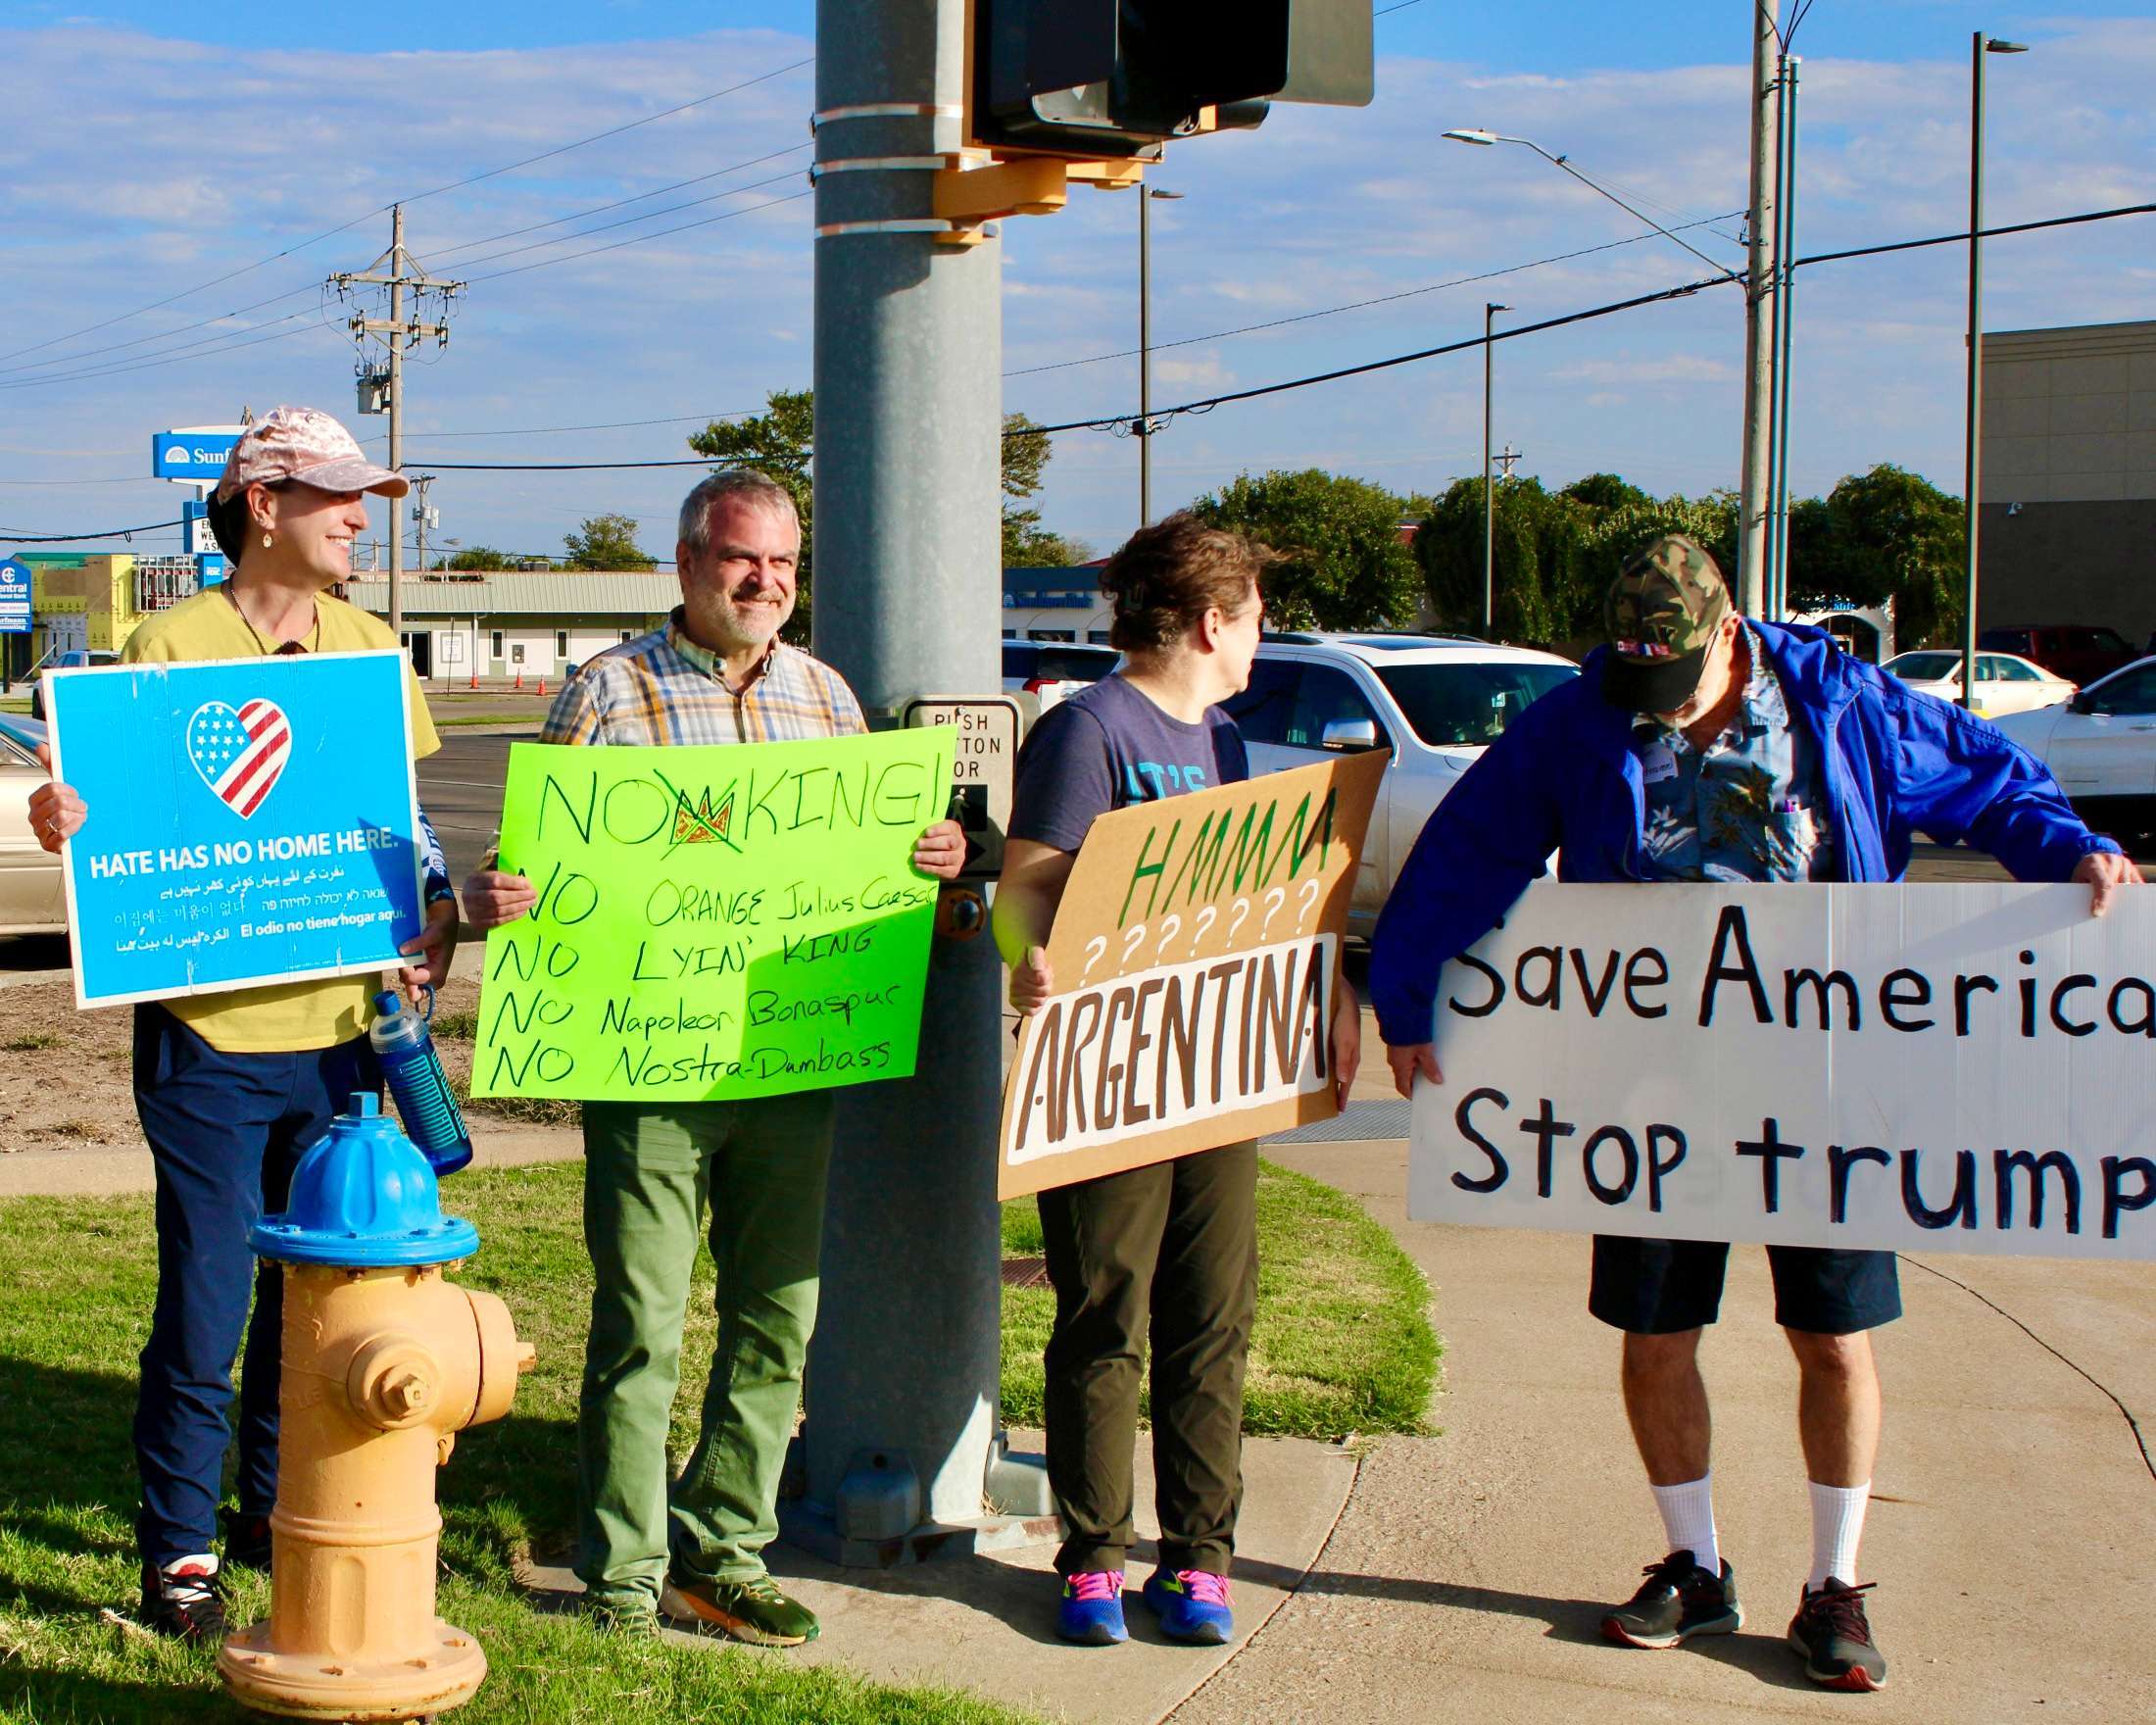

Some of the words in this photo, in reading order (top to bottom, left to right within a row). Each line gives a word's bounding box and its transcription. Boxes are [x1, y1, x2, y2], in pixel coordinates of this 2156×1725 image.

[956, 737, 1001, 754] TON
[537, 770, 670, 845] NO
[90, 850, 155, 879] HATE
[159, 844, 209, 872] HAS
[214, 839, 253, 866] NO
[258, 832, 332, 862] HOME
[336, 826, 399, 854] HERE.
[1117, 786, 1337, 931] HMMM
[240, 923, 253, 938] El
[255, 920, 284, 936] odio
[286, 919, 304, 933] no
[306, 914, 339, 929] tiene
[341, 912, 375, 927] hogar
[646, 878, 766, 927] ORANGE
[777, 880, 855, 920] Julius
[859, 875, 937, 911] Caesar
[493, 934, 579, 981] NO
[632, 934, 753, 981] LYIN'
[783, 924, 878, 965] KING
[1449, 915, 1668, 1019] Save
[1697, 904, 2156, 1040] America
[601, 996, 735, 1042] Napoleon
[748, 985, 902, 1028] Bonaspur
[489, 1039, 574, 1091] NO
[1014, 941, 1327, 1152] ARGENTINA
[1449, 1087, 1688, 1213] Stop
[1735, 1116, 2156, 1240] trump
